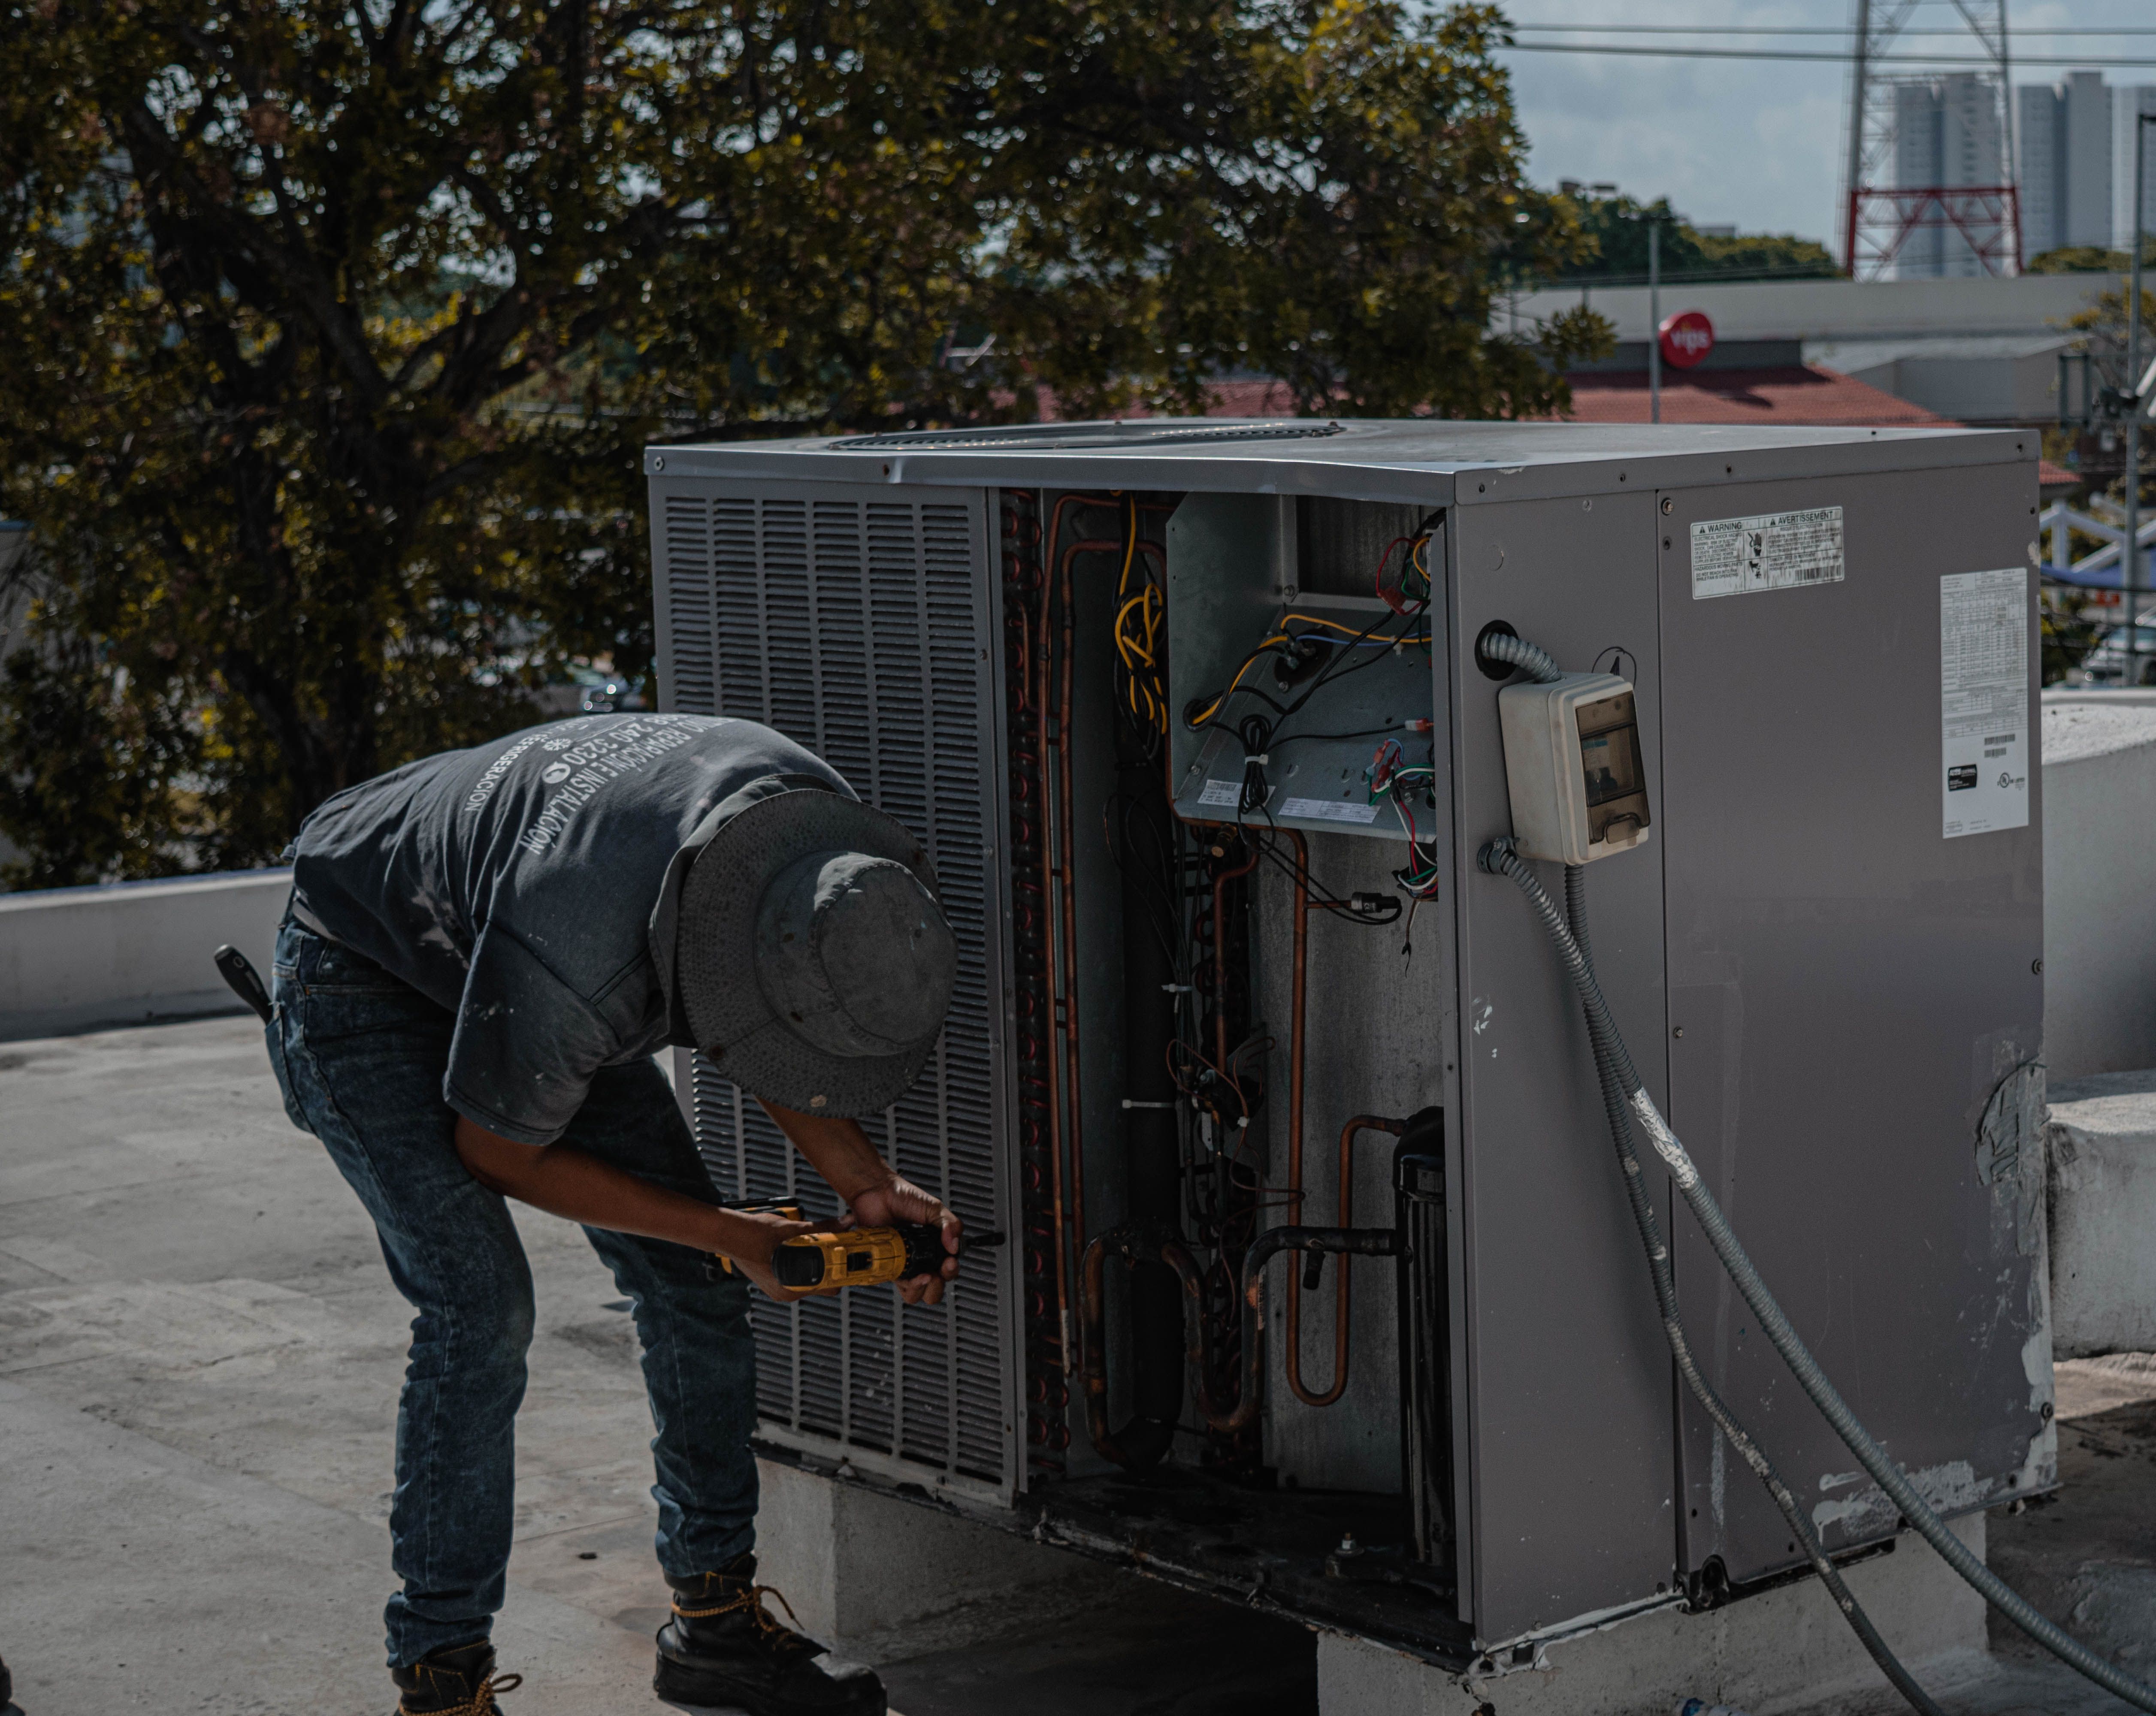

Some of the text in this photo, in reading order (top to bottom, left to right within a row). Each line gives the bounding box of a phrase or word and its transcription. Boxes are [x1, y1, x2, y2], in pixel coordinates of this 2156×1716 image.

[1708, 522, 1742, 533] WARNING
[1778, 511, 1833, 525] AVERTISSEMENT
[609, 722, 653, 743] 240
[562, 738, 618, 765] 3230
[601, 728, 692, 772] REPARACIÓN
[590, 761, 619, 777] E
[519, 767, 609, 855] INSTALACIÓN
